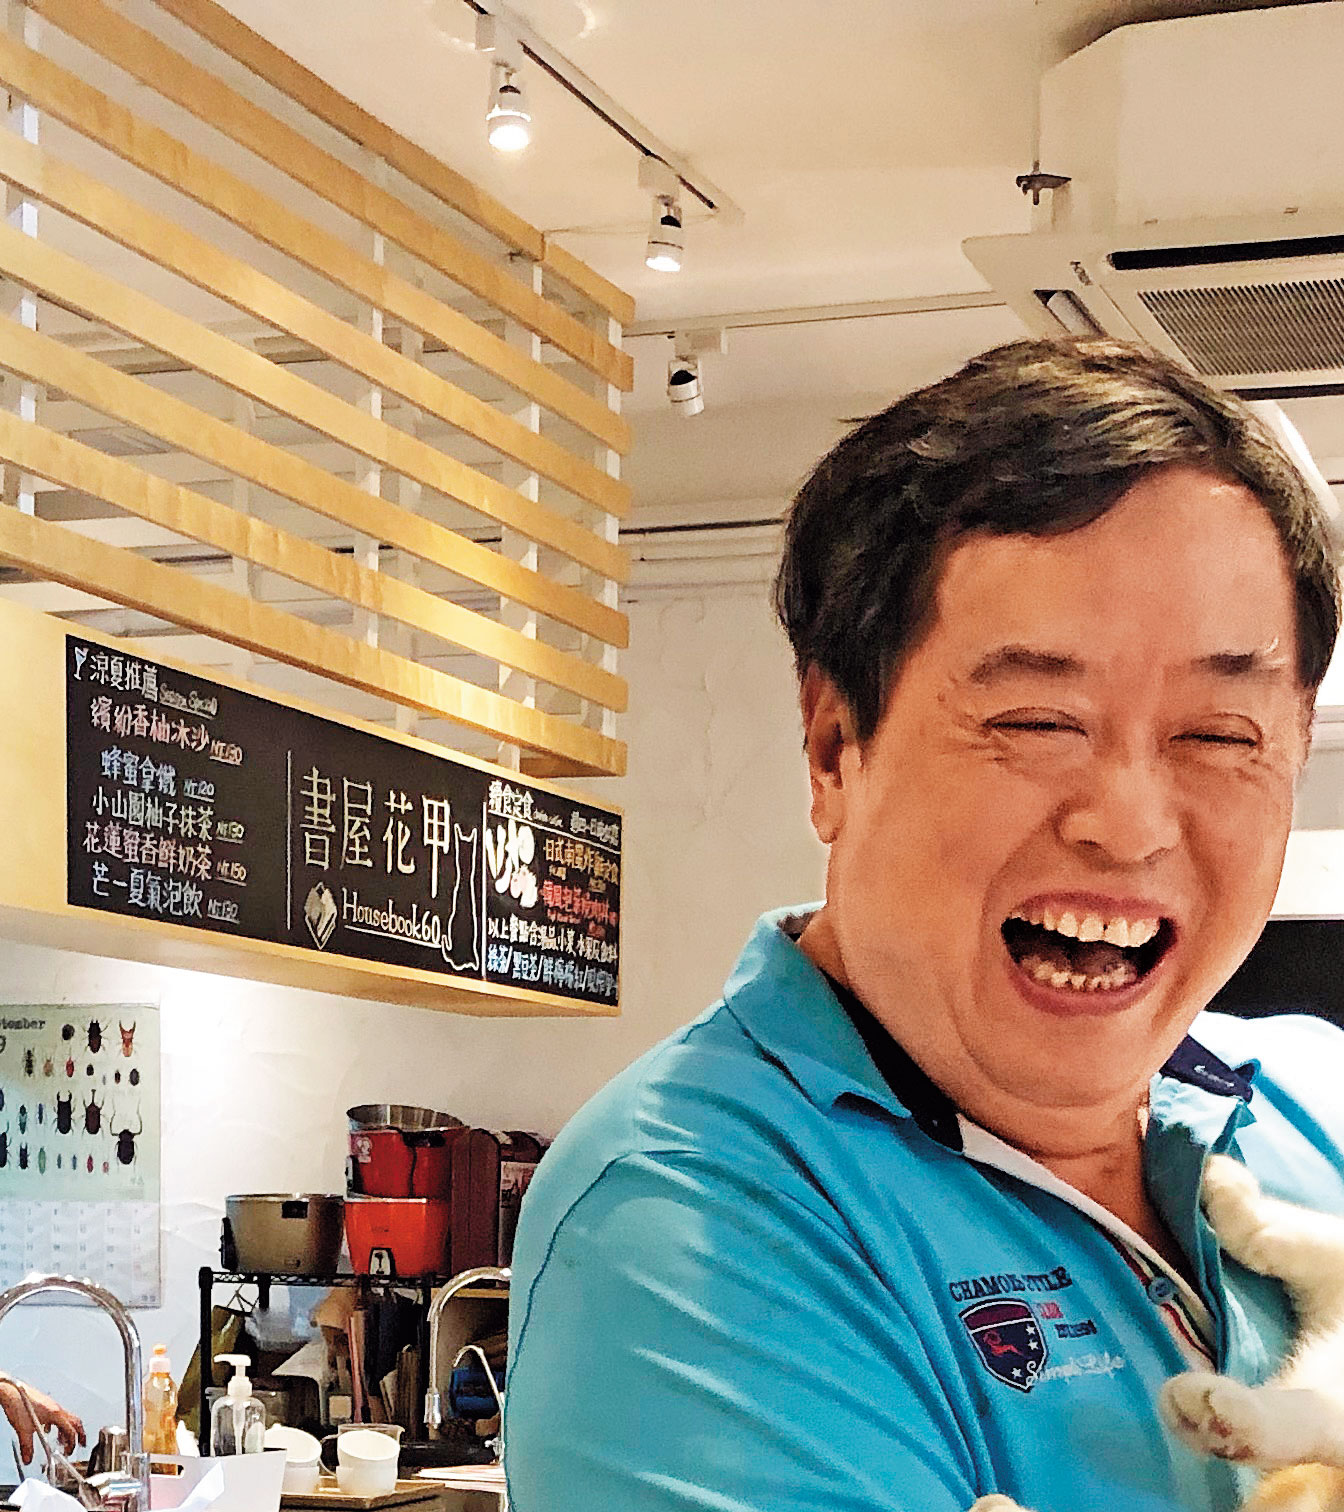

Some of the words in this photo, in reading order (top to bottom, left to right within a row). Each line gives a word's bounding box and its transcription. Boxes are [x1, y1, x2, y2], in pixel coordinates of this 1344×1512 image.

[299, 765, 451, 899] 書屋花甲
[342, 886, 442, 945] Housebook60
